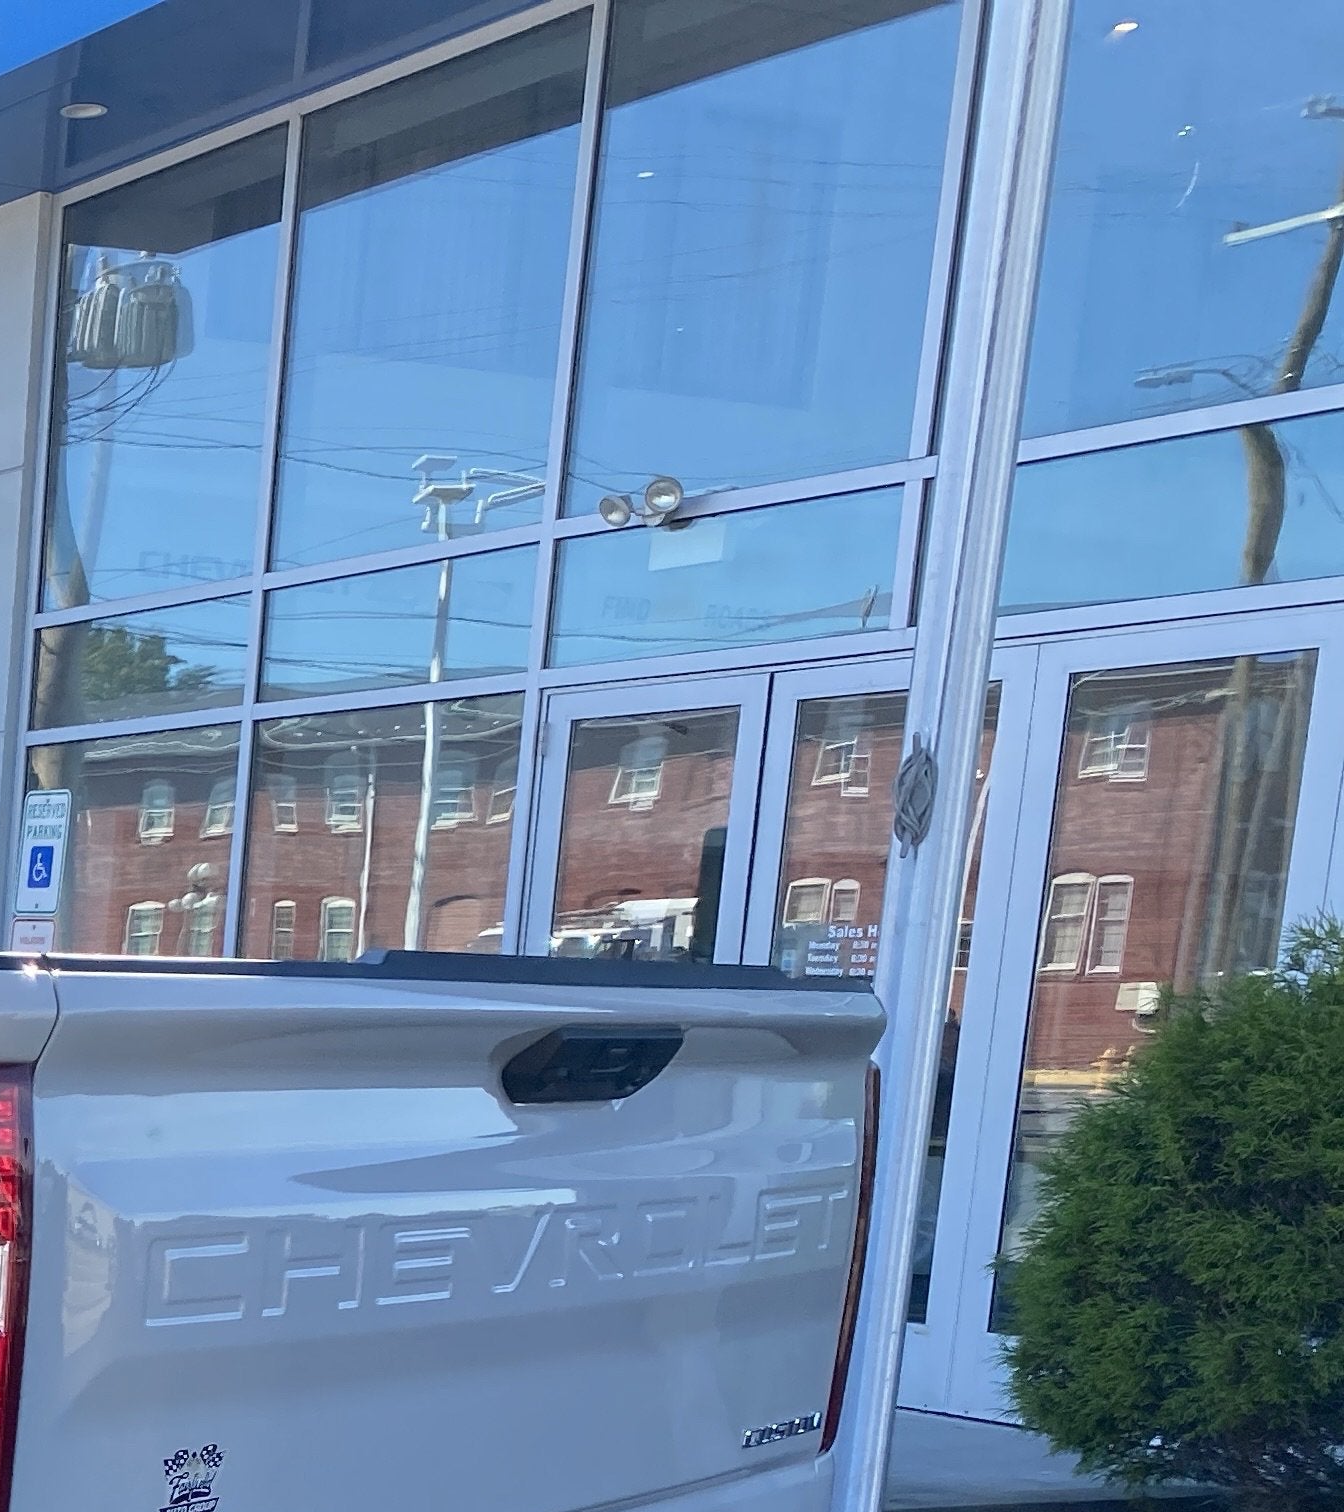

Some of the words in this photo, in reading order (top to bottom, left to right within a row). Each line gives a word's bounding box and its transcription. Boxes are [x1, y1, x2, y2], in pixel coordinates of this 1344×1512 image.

[27, 802, 67, 819] RESERVED
[26, 824, 63, 839] PARKING
[827, 924, 864, 939] Sales
[144, 1188, 853, 1326] CHEVROLET
[741, 1411, 822, 1449] CUSTOM
